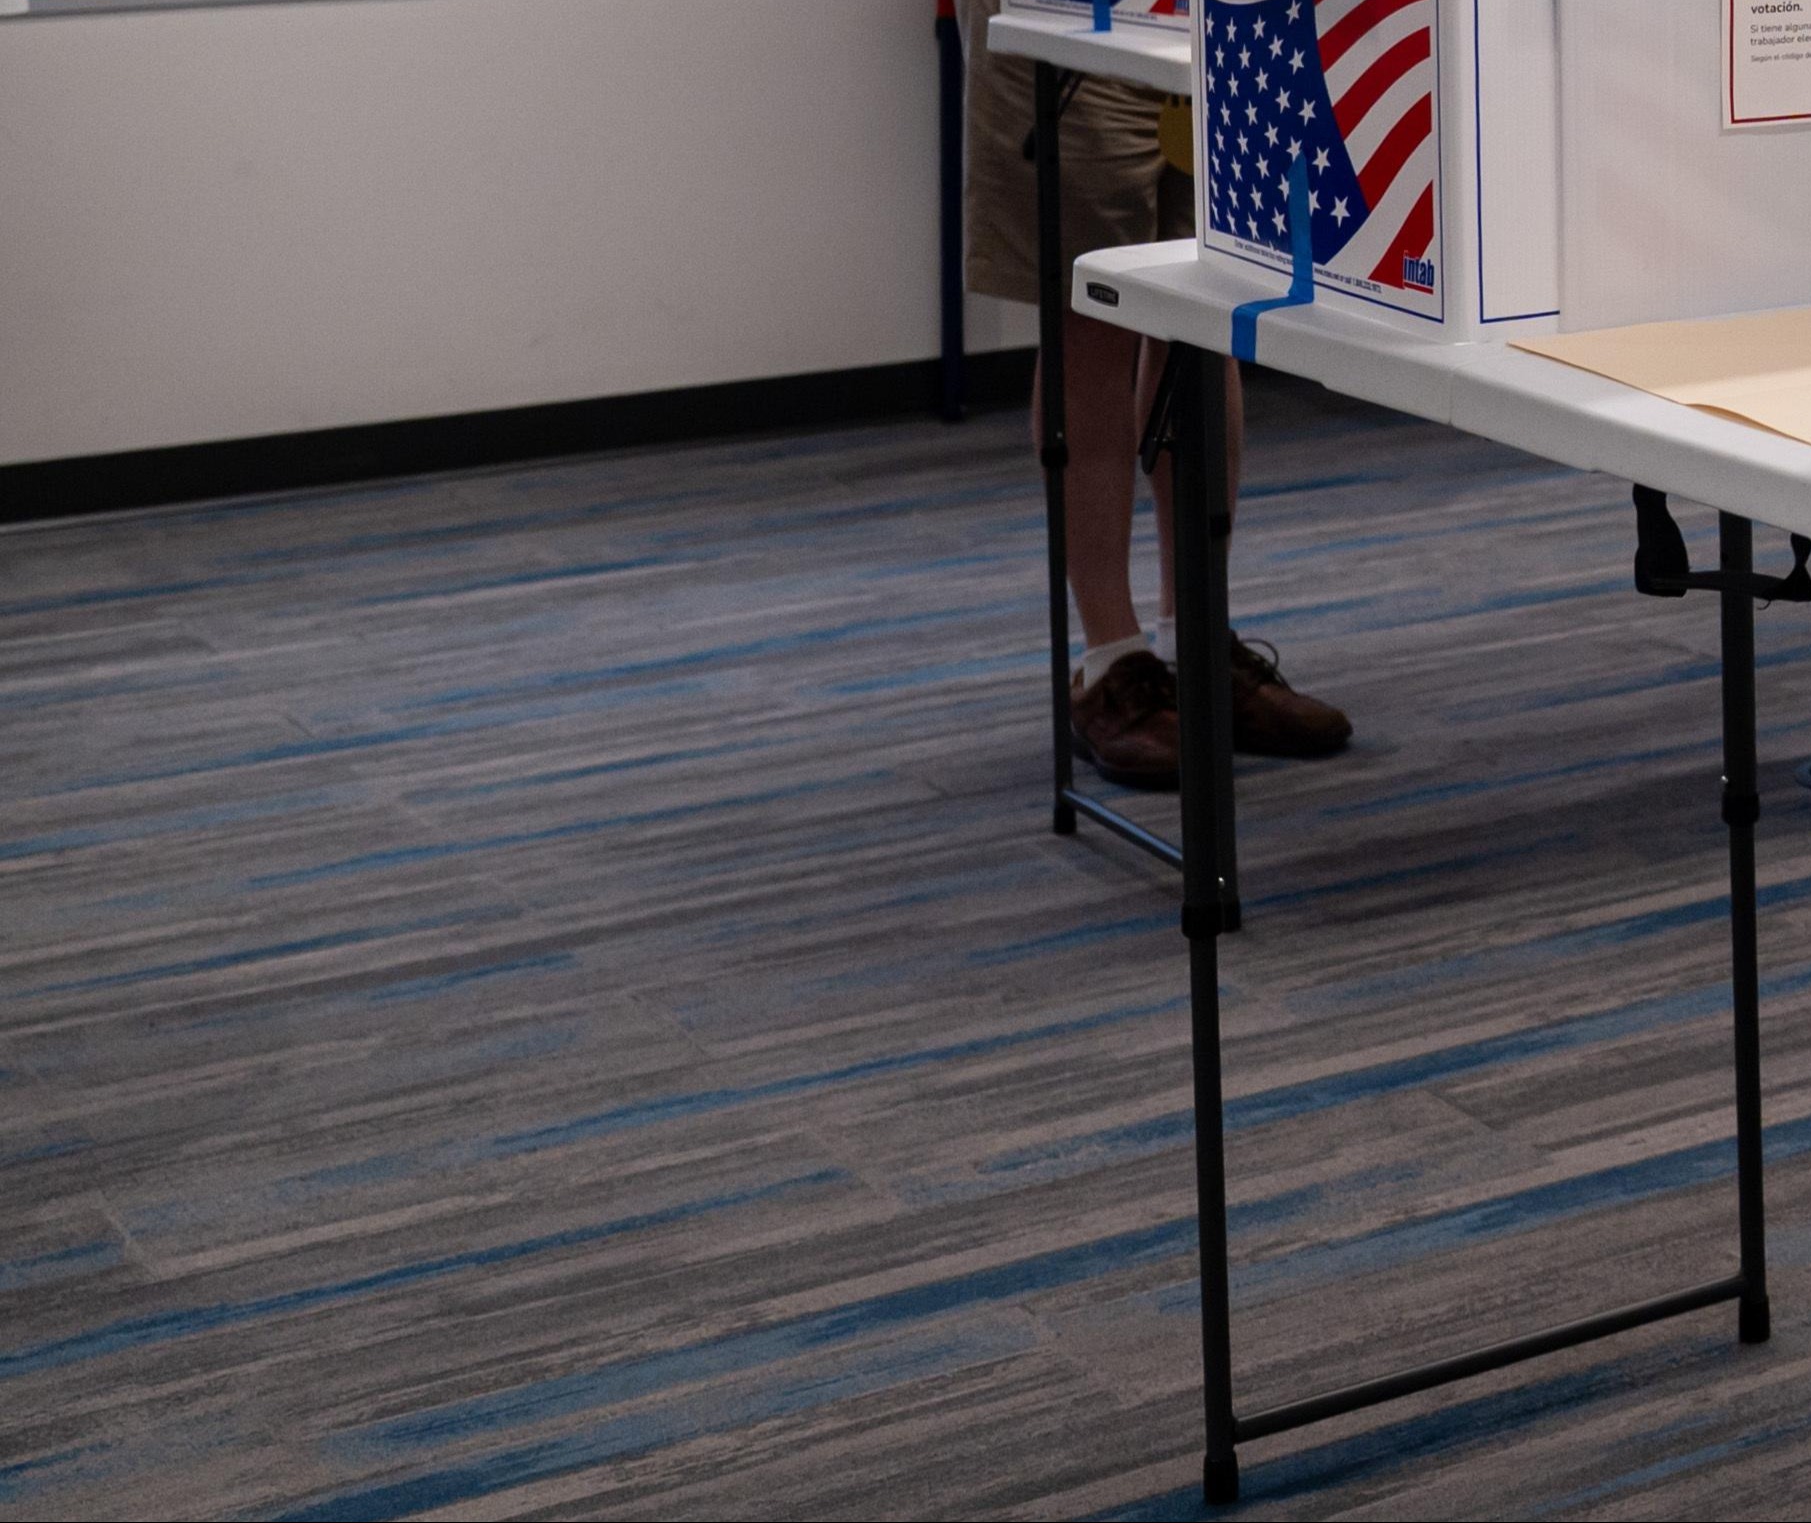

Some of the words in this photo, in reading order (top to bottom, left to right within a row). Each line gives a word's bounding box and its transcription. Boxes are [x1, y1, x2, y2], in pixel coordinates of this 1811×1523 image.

[1751, 1, 1803, 15] votación.
[1750, 24, 1760, 34] Si
[1761, 23, 1783, 33] tiene
[1750, 34, 1795, 47] trabajador
[1404, 250, 1434, 288] intab
